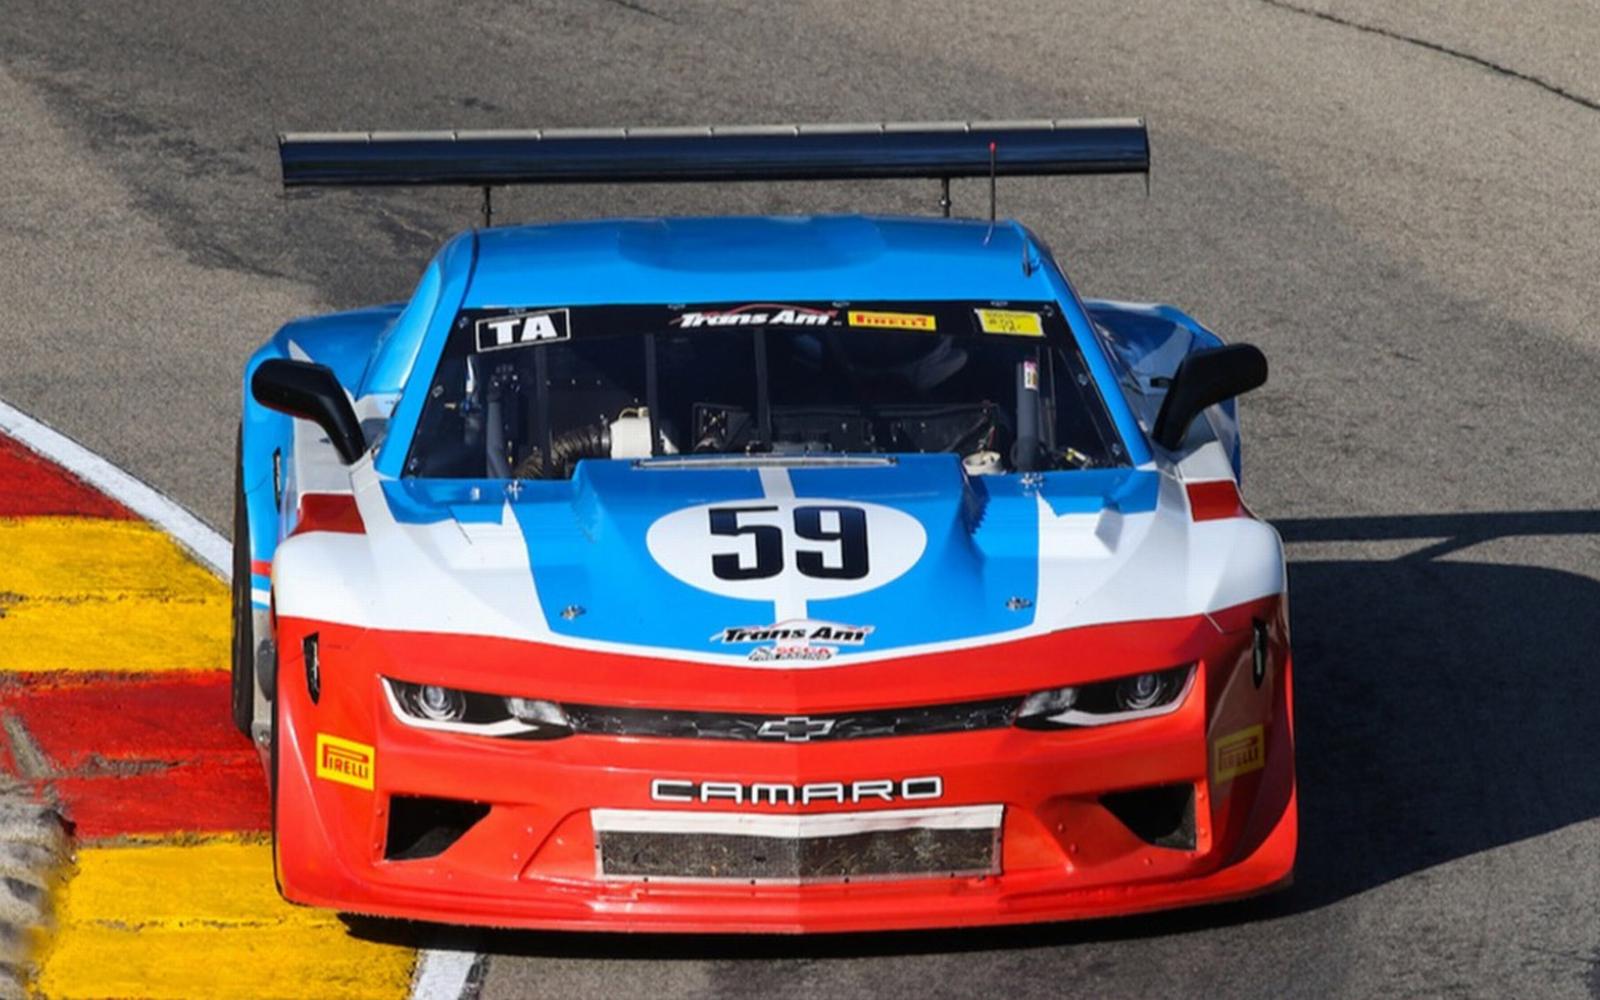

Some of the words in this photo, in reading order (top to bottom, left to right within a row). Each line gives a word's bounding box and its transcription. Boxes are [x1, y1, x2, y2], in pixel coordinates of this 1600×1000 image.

[488, 314, 559, 345] TA
[679, 311, 769, 328] Trans
[769, 309, 830, 326] Am
[855, 313, 928, 328] PIRELLI
[708, 505, 869, 581] 59
[725, 628, 807, 643] Trans
[809, 625, 866, 641] Am
[322, 743, 370, 780] PIRELLI
[1218, 735, 1259, 773] PIRELLI
[650, 776, 944, 806] CAMARO
